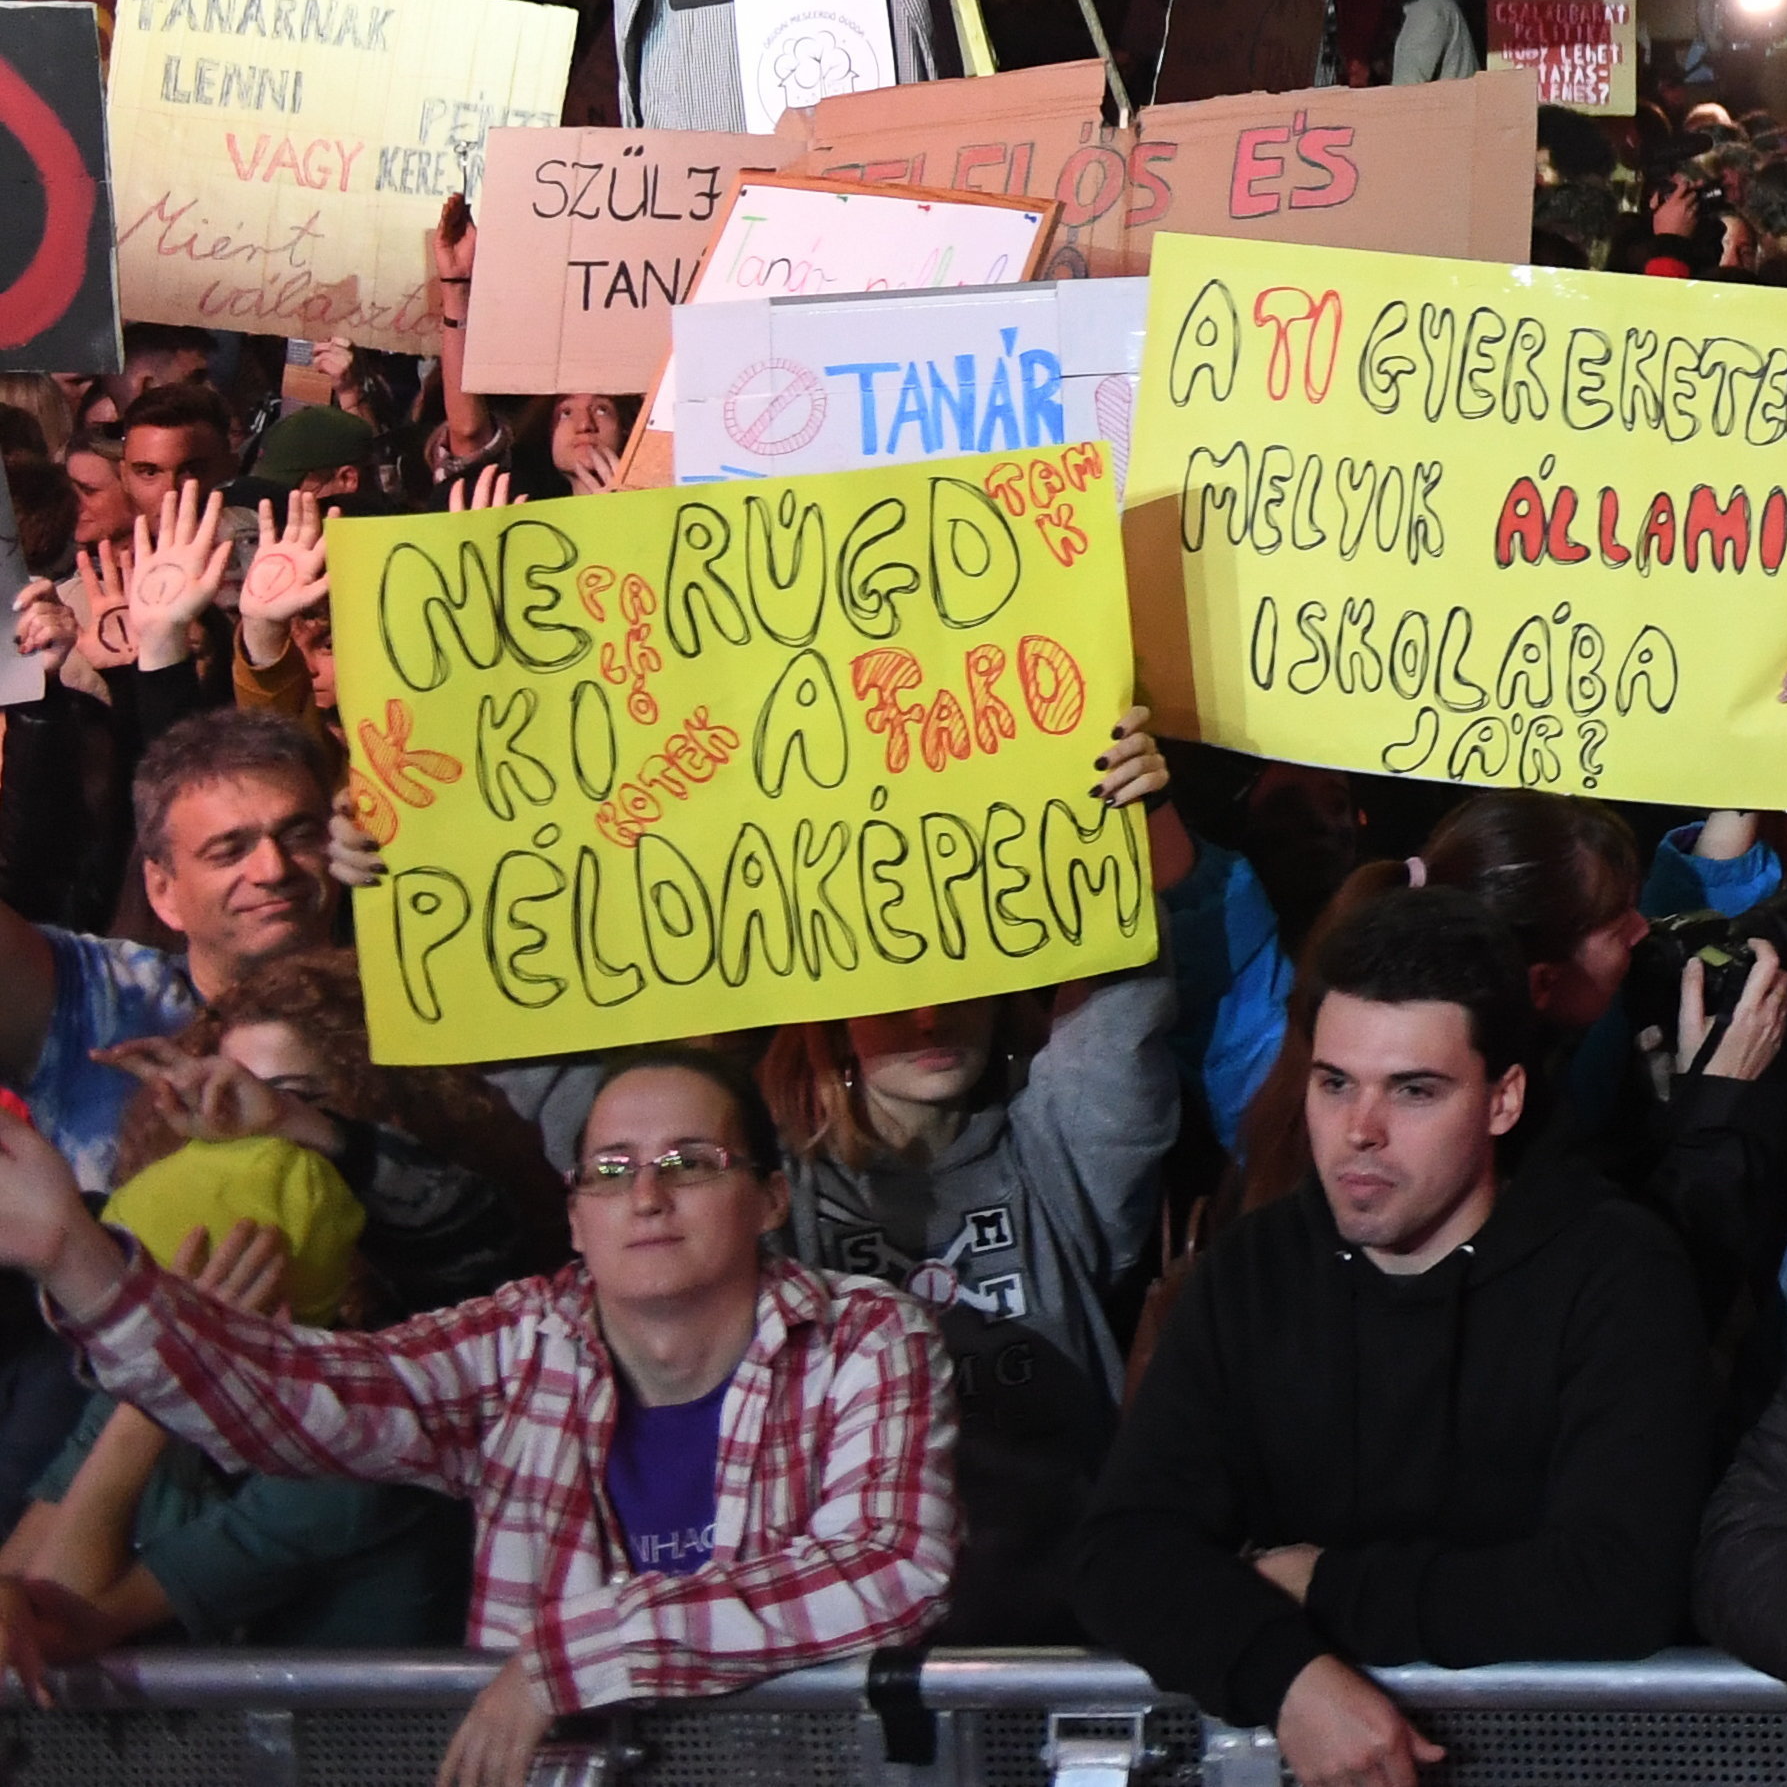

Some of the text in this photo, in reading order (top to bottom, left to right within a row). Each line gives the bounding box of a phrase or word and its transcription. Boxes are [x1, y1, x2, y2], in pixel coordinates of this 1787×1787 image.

[160, 55, 304, 114] LENNI
[1560, 42, 1623, 65] LEHET
[225, 131, 367, 193] VAGY
[532, 145, 777, 220] SZÜLJ
[1227, 108, 1361, 221] ÉS
[823, 326, 1065, 456] TANÁR
[1169, 279, 1242, 407] A
[1252, 286, 1343, 404] TI
[1180, 439, 1445, 565] MELYIK
[379, 476, 1022, 692] NE RÚGD
[1249, 595, 1679, 717] ISKOLÁBA
[474, 680, 620, 821] KI
[751, 648, 848, 799] A
[1381, 705, 1609, 790] JÁR?
[392, 785, 1144, 1023] PÉLDAKÉPEM
[970, 1211, 1012, 1248] M
[982, 1275, 1018, 1316] T
